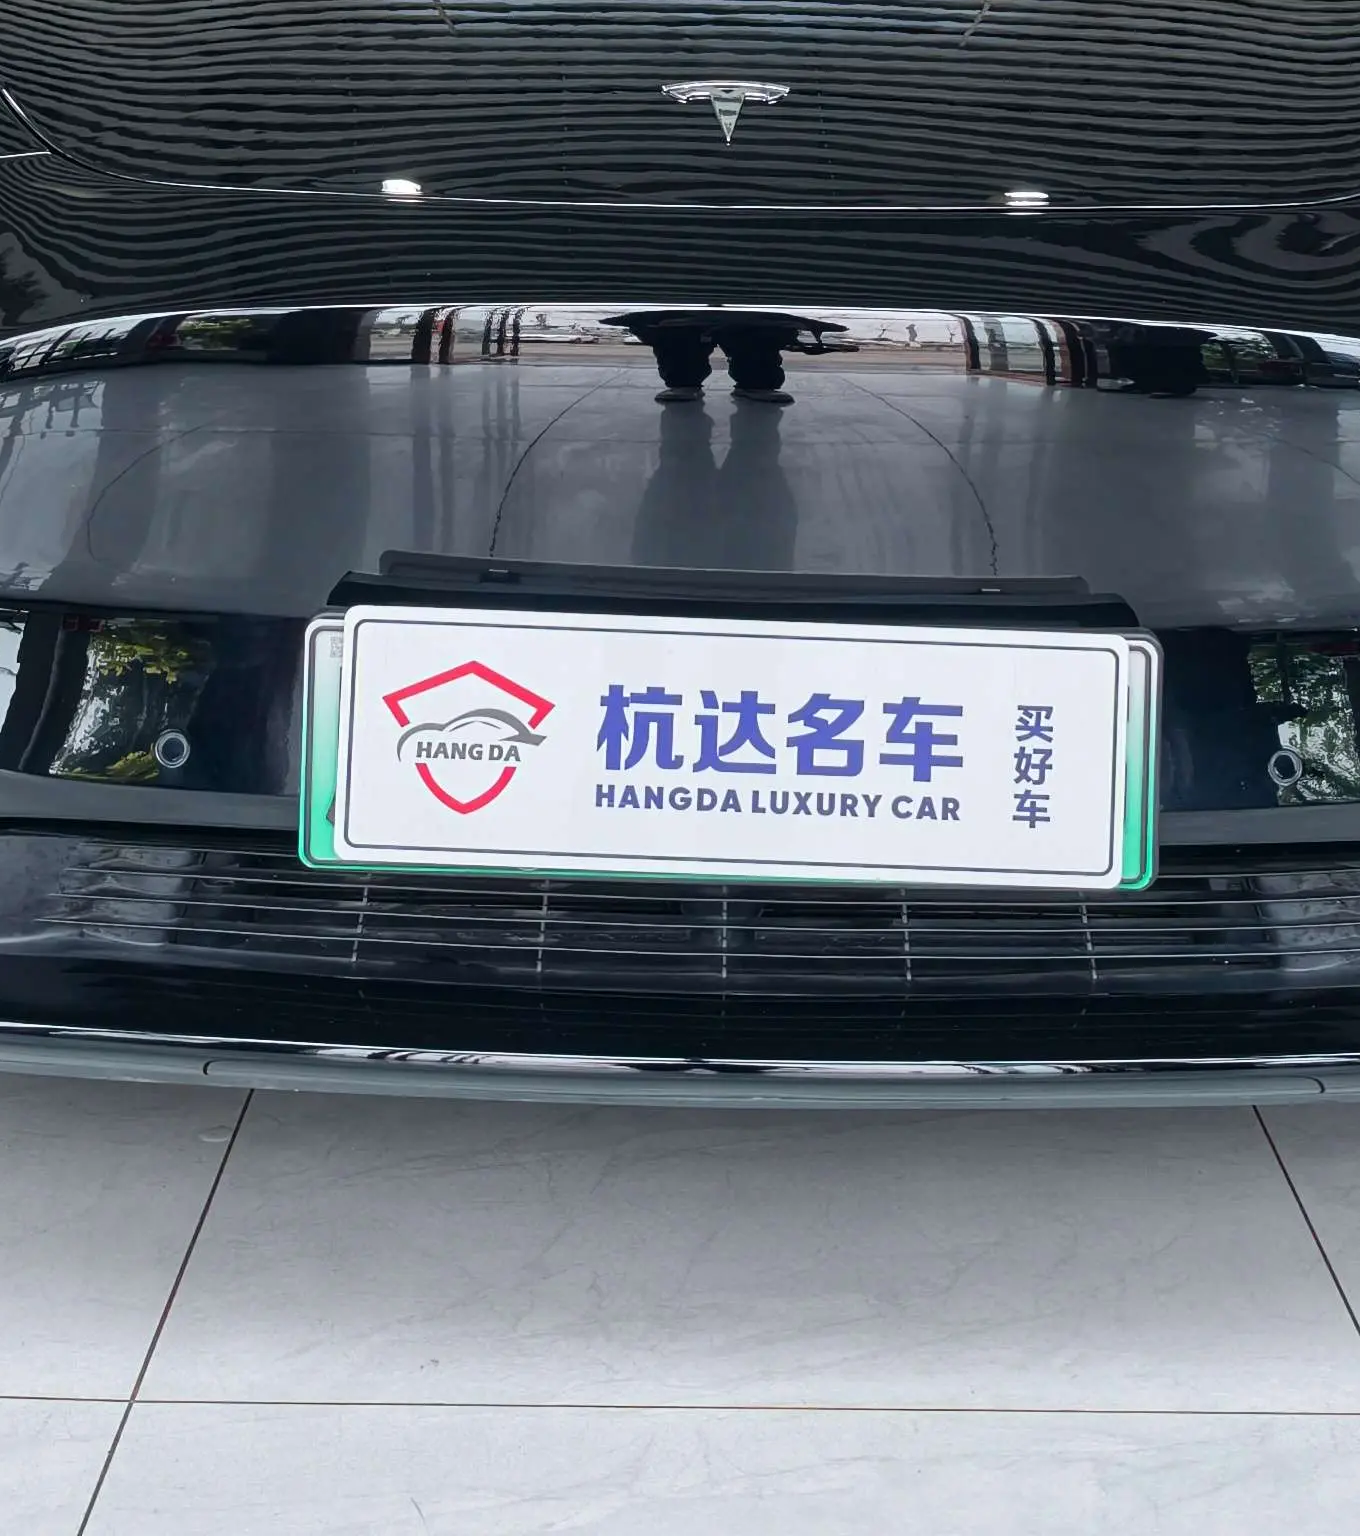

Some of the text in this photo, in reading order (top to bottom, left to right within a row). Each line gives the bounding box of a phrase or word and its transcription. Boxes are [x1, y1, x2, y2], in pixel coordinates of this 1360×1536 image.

[415, 741, 522, 763] HANG DA
[596, 684, 964, 783] 杭达名车
[1011, 704, 1055, 829] 买好车
[594, 783, 961, 822] HANGDA LUXURY CAR
